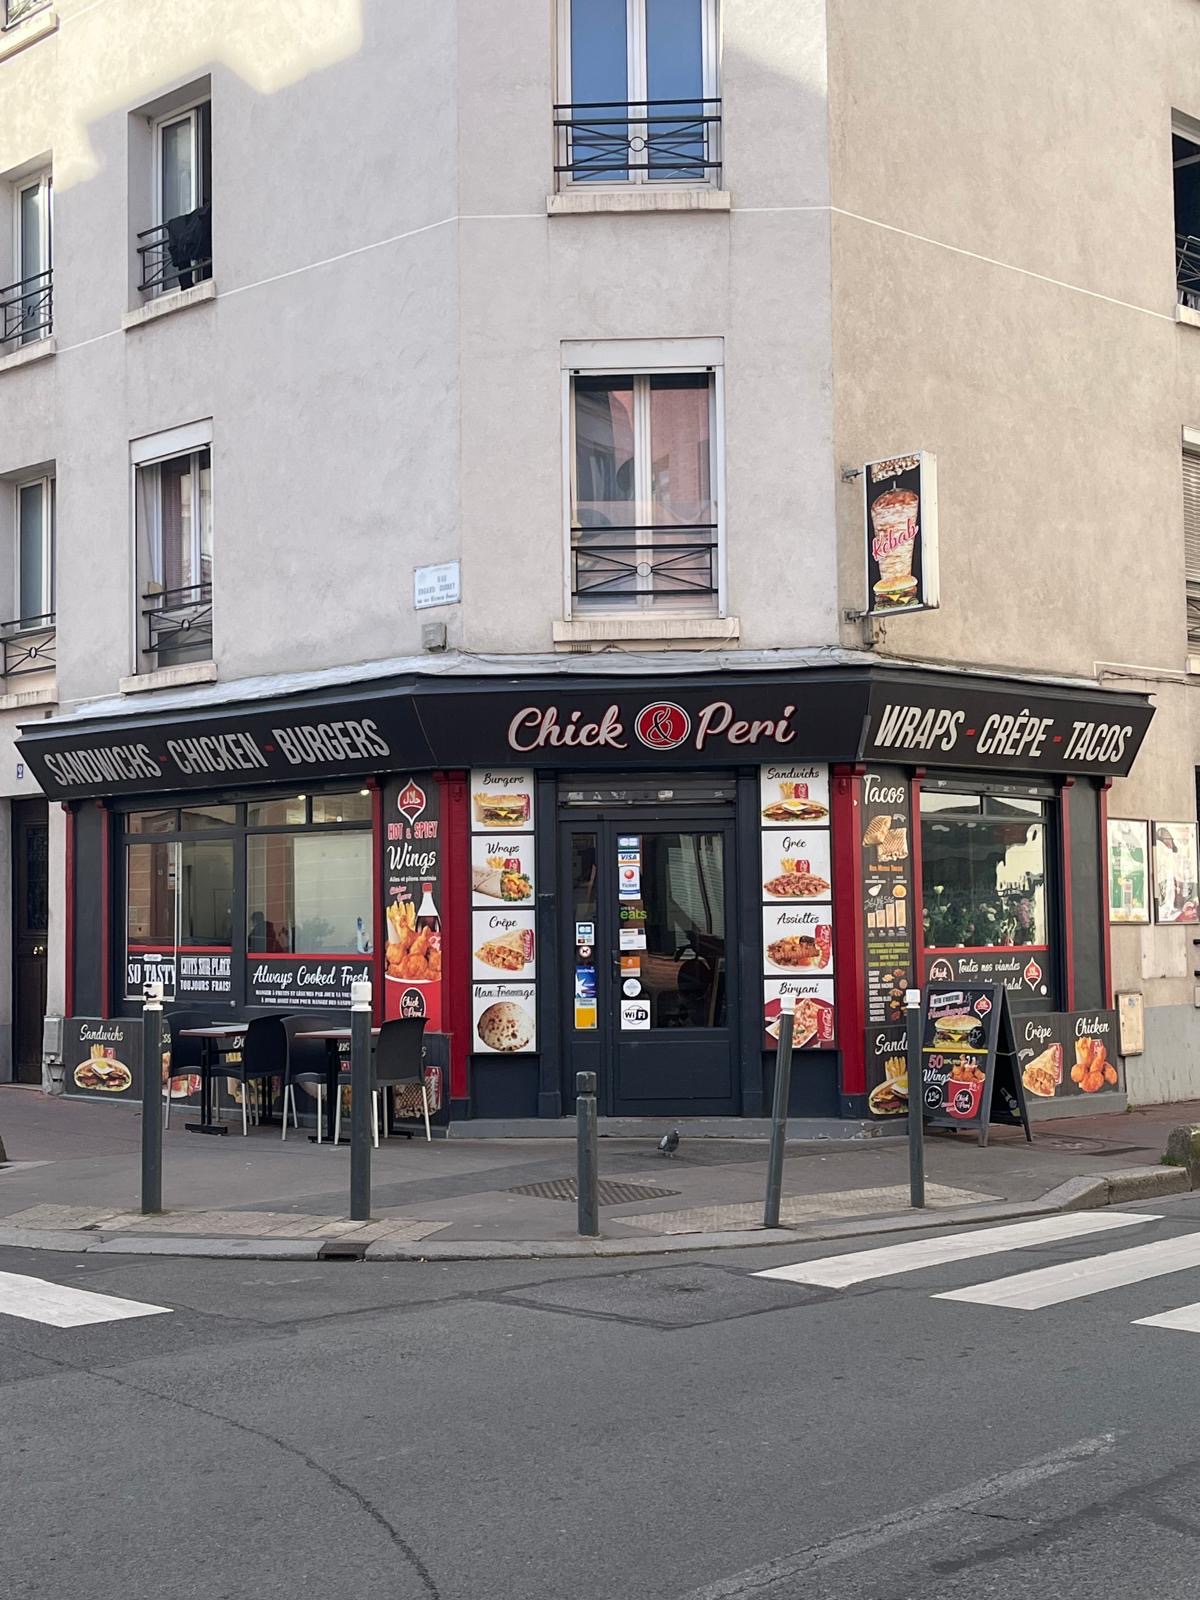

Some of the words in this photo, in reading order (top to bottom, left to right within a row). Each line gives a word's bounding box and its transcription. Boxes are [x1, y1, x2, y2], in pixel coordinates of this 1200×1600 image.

[872, 518, 919, 562] Kebab
[508, 704, 628, 751] Chick
[643, 704, 687, 746] &
[695, 701, 797, 750] Peri
[873, 704, 965, 751] WRAPS
[976, 708, 1054, 757] CRÊPE
[1062, 721, 1133, 763] TACOS
[44, 743, 162, 786] SANDWICHS
[166, 732, 269, 775] CHICKEN
[271, 718, 391, 765] BURGERS
[482, 772, 524, 788] Burgers
[767, 767, 820, 780] Sandwichs
[863, 774, 905, 805] Tacos
[388, 823, 404, 840] HOT
[414, 820, 438, 839] SPICY
[486, 842, 520, 856] Wraps
[386, 842, 437, 876] Wings
[488, 915, 518, 930] Crêpe
[620, 909, 648, 920] eats
[777, 912, 820, 925] Assiettes
[128, 964, 140, 984] SO
[144, 964, 176, 985] TASTY
[212, 958, 231, 976] PLACE
[958, 958, 979, 974] Toutes
[981, 962, 993, 972] nos
[994, 957, 1021, 972] viandes
[180, 980, 210, 992] TOUJOURS
[212, 980, 232, 992] FRAIS!
[252, 965, 293, 990] Always
[296, 965, 336, 986] Cooked
[340, 966, 369, 986] Fresh
[779, 982, 820, 996] Biryani
[402, 996, 420, 1008] Chick
[80, 1024, 124, 1042] Sandwichs
[1024, 1022, 1052, 1044] Crêpe
[1075, 1016, 1110, 1037] Chicken
[928, 1054, 944, 1069] 50
